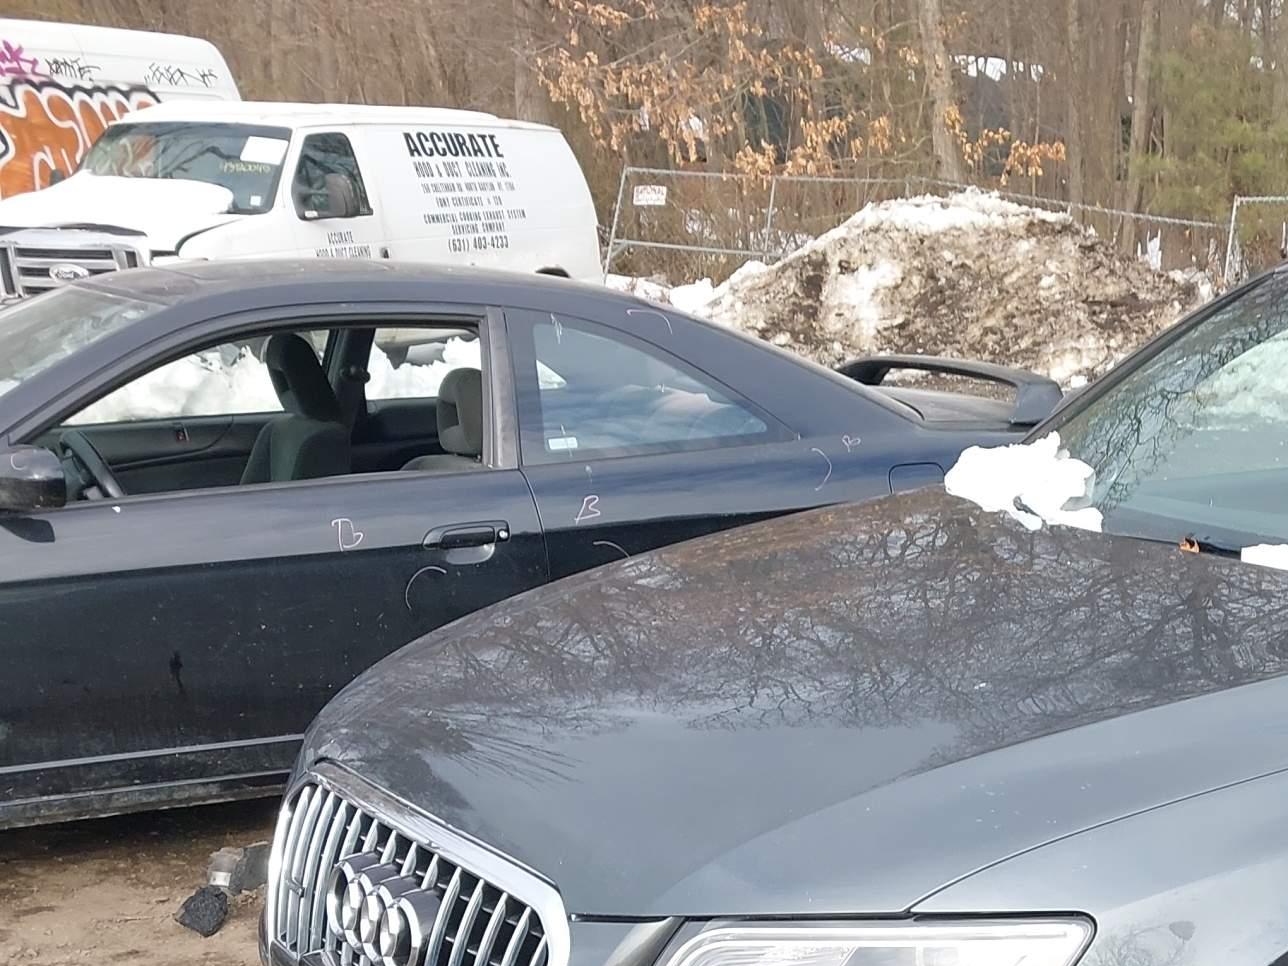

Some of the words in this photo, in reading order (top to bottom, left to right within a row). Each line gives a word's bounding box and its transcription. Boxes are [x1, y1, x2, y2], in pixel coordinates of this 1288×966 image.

[403, 132, 504, 158] ACCURATE
[413, 161, 433, 178] HOOD
[443, 161, 462, 178] DUCT
[464, 161, 497, 178] CLEANING
[451, 196, 484, 207] CERTIFICATE
[423, 212, 458, 224] COMMERCIAL
[459, 211, 482, 222] COOKING
[482, 209, 505, 221] EXHAUST
[506, 208, 526, 220] SYSTEM
[451, 223, 478, 235] SERVICING
[481, 221, 505, 233] COMPANY
[327, 231, 354, 245] ACCURATE
[448, 237, 470, 253] (631)
[473, 235, 509, 250] 403-4233
